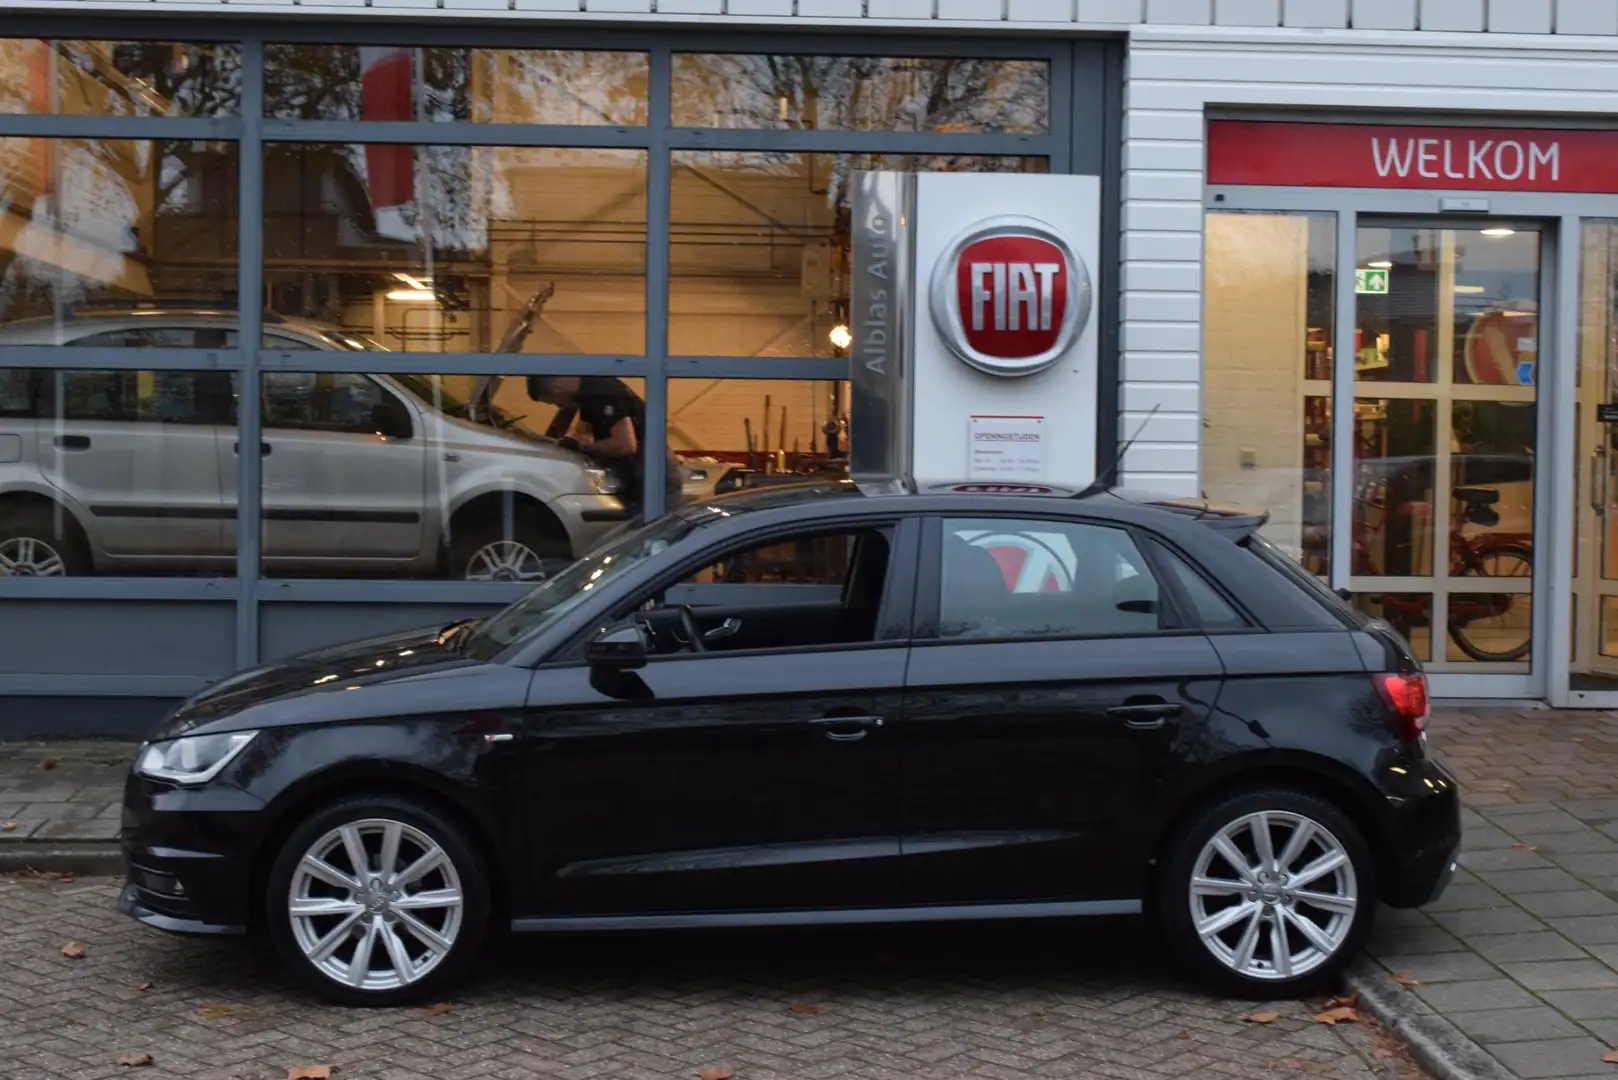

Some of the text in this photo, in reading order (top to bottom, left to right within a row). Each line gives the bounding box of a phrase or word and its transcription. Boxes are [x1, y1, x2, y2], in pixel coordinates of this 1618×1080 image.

[1371, 137, 1560, 181] WELKOM
[863, 289, 887, 375] Alblas
[970, 262, 1060, 332] FIAT
